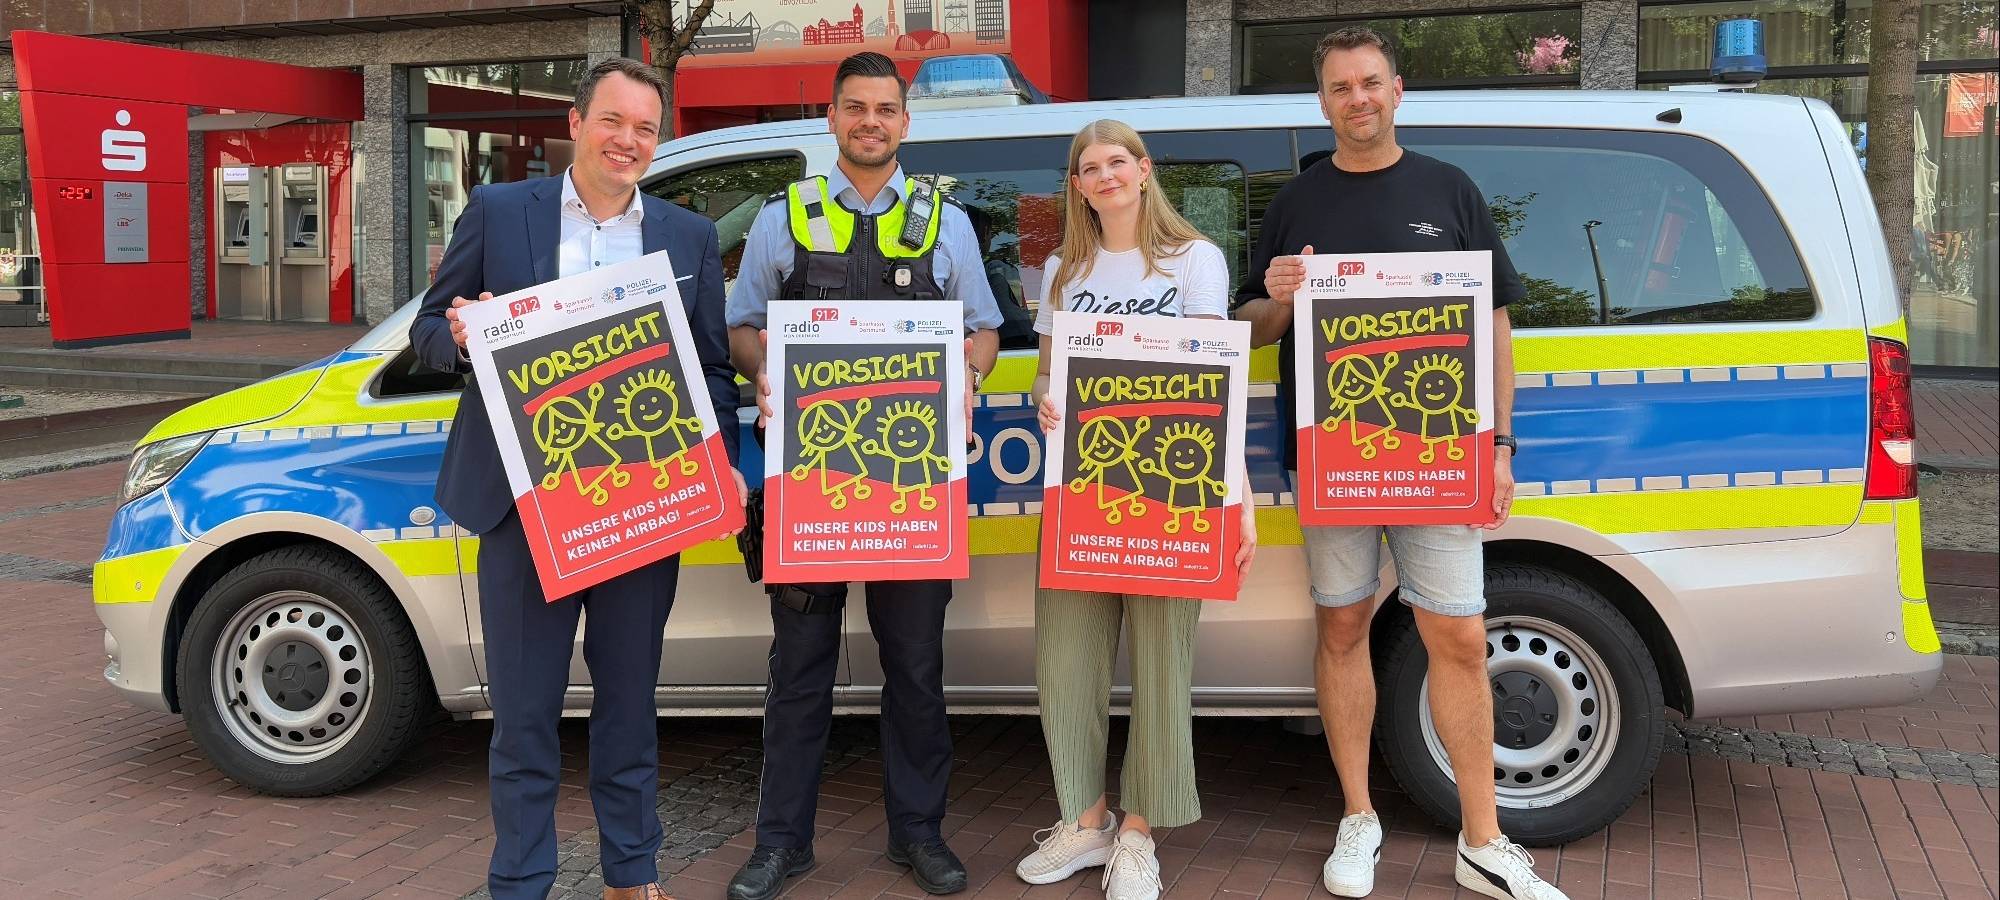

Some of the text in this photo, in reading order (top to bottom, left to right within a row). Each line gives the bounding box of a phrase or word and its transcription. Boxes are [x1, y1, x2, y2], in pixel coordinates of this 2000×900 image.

[1342, 263, 1364, 275] 91.2
[626, 278, 652, 290] POLIZEI
[1310, 275, 1346, 288] radio
[514, 299, 538, 315] 91.2
[1071, 286, 1178, 317] Diesel
[815, 310, 838, 321] 91.2
[1320, 303, 1469, 344] VORSICHT
[483, 318, 524, 339] radio
[784, 320, 820, 333] radio
[1100, 323, 1122, 336] 91.2
[1068, 333, 1104, 347] radio
[507, 311, 660, 394] VORSICHT
[793, 351, 941, 389] VORSICHT
[1075, 373, 1224, 403] VORSICHT
[1326, 469, 1466, 482] UNSERE KIDS HABEN
[1326, 487, 1377, 498] KEINEN
[1380, 486, 1435, 498] AIRBAG!
[561, 481, 707, 544] UNSERE KIDS HABEN
[567, 531, 622, 561] KEINEN
[625, 509, 681, 540] AIRBAG!
[793, 519, 939, 535] UNSERE KIDS HABEN
[793, 538, 846, 552] KEINEN
[850, 537, 907, 551] AIRBAG!
[1070, 534, 1210, 554] UNSERE KIDS HABEN
[1069, 550, 1119, 564] KEINEN
[1123, 554, 1178, 568] AIRBAG!
